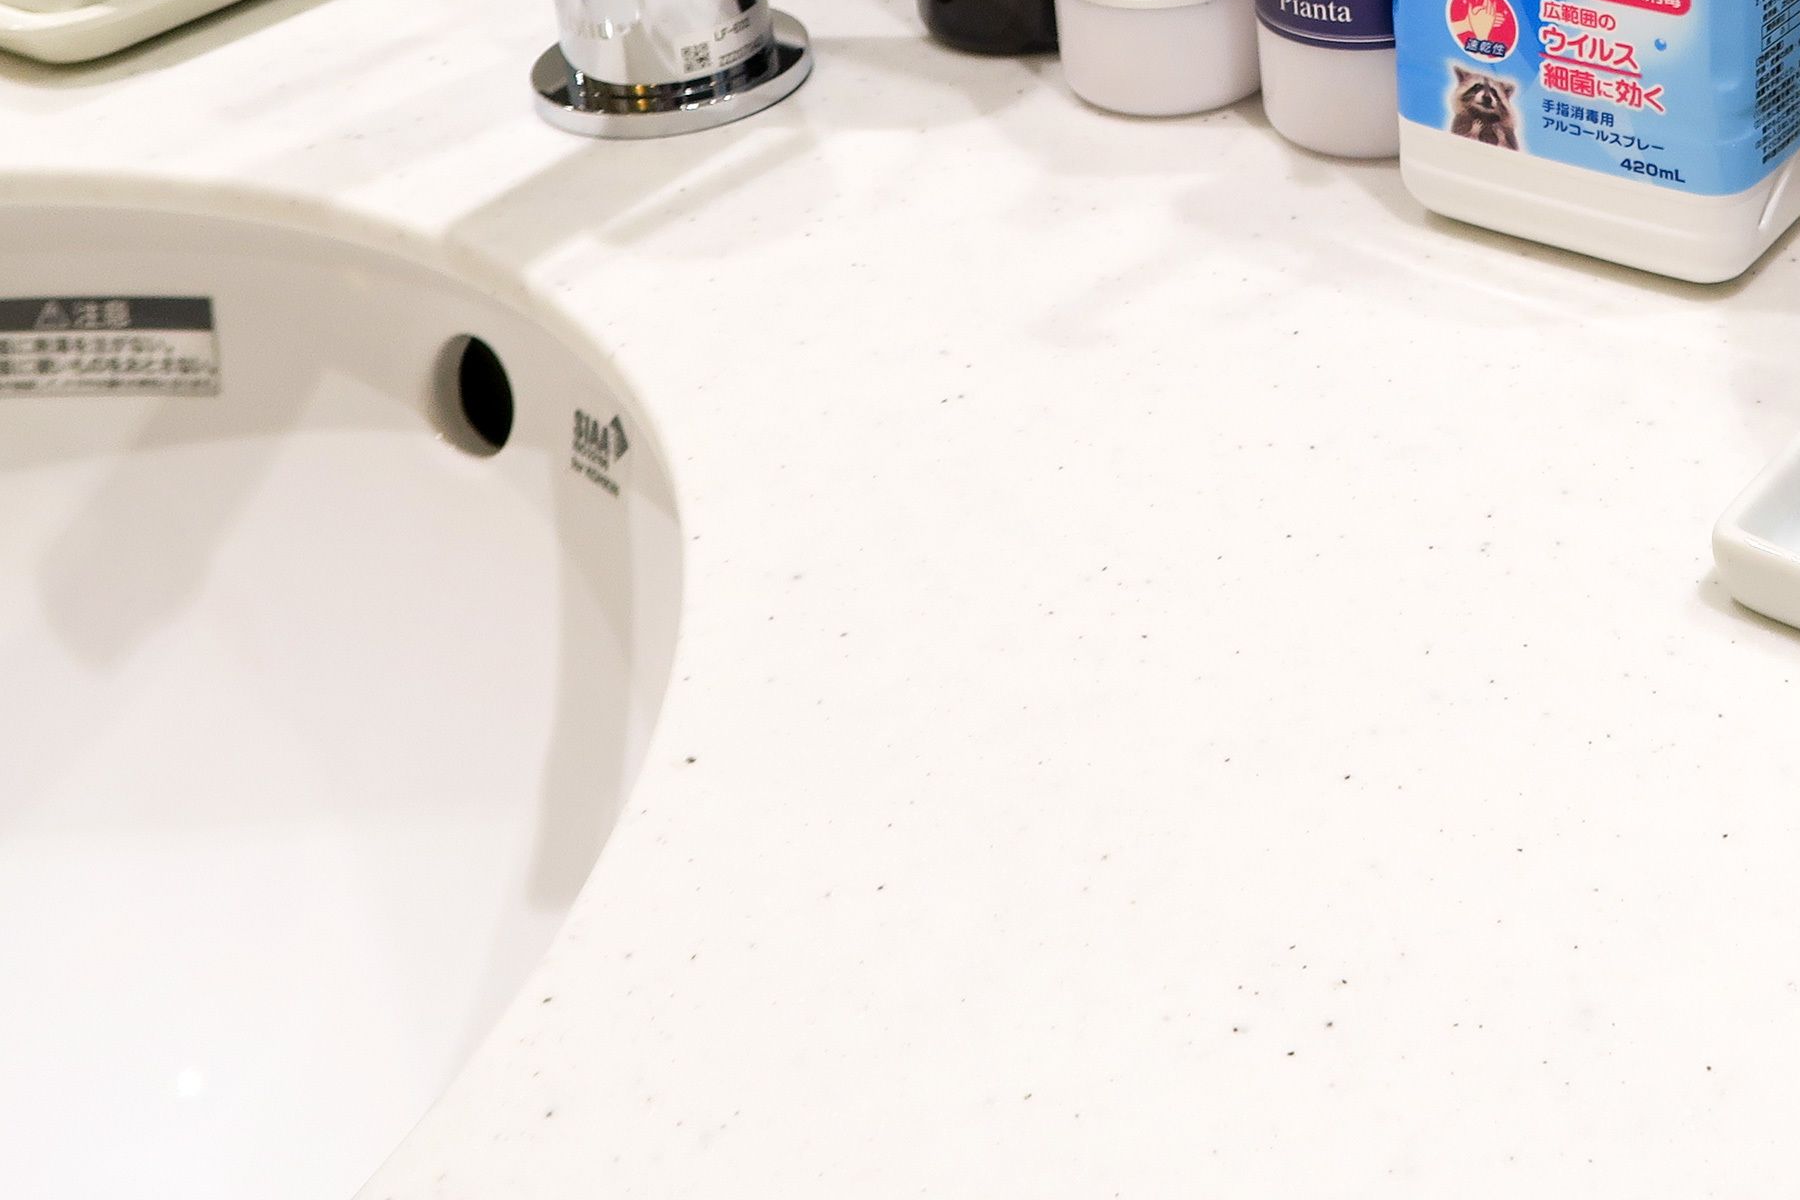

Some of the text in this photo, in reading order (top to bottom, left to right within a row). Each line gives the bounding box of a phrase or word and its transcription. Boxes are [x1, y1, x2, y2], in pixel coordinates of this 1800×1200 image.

[1543, 2, 1616, 31] 広範囲の
[1465, 39, 1506, 57] 速乾性
[1542, 27, 1638, 70] ウイルス
[1543, 63, 1664, 112] 細菌に効く
[1542, 99, 1614, 128] 手指消毒用
[1542, 116, 1665, 151] アルコールスプレー
[1620, 158, 1686, 183] 420mL
